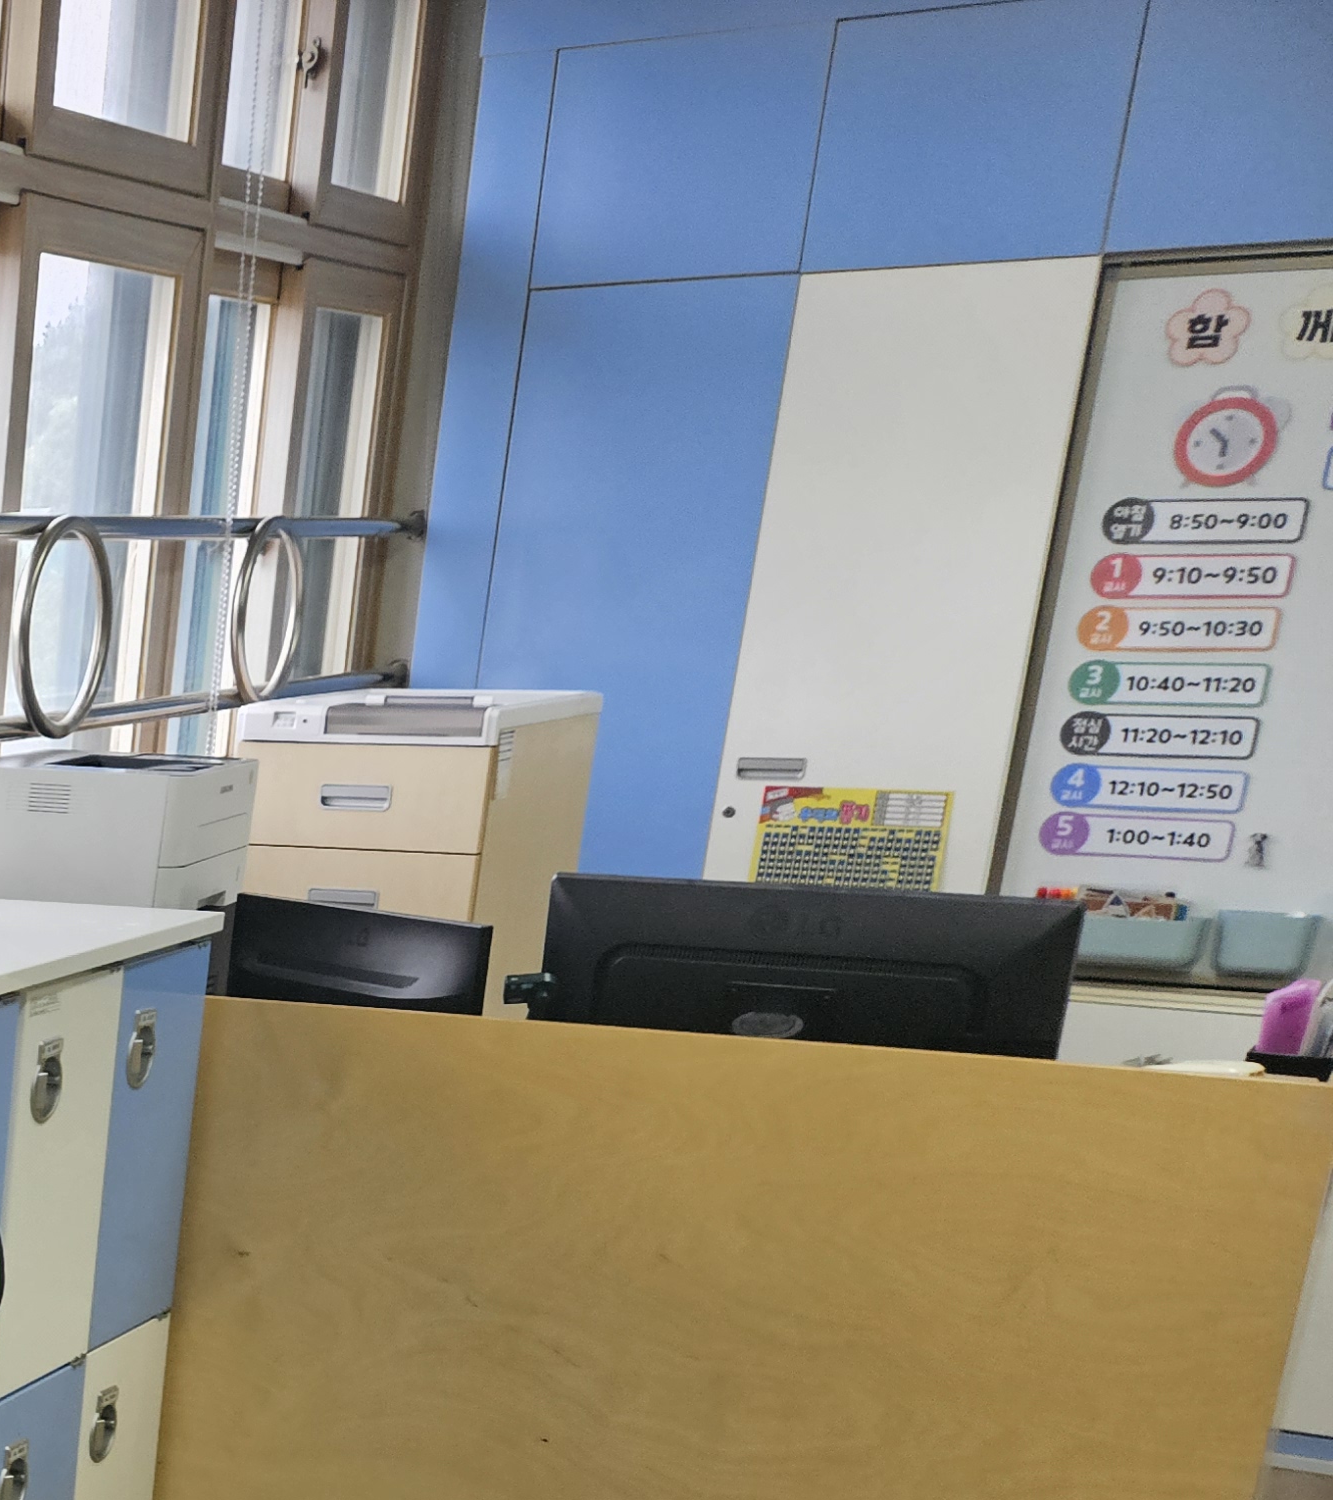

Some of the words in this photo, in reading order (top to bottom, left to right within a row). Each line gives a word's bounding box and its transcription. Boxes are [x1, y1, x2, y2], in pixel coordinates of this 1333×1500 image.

[1186, 314, 1229, 350] 함
[1169, 513, 1288, 530] 8:50~9:00
[1110, 557, 1123, 578] 1
[1152, 567, 1277, 584] 9:10~9:50
[1095, 611, 1112, 631] 2
[1138, 621, 1263, 637] 9:50~10:30
[1086, 665, 1103, 686] 3
[1126, 676, 1256, 693] 10:40~11:20
[1072, 718, 1102, 734] 점심
[1068, 735, 1100, 751] 시간
[1121, 728, 1243, 745] 11:20~12:10
[1067, 768, 1085, 788] 4
[1108, 780, 1233, 799] 12:10~12:50
[1056, 815, 1074, 836] 5
[1106, 828, 1211, 847] 1:00~1:40
